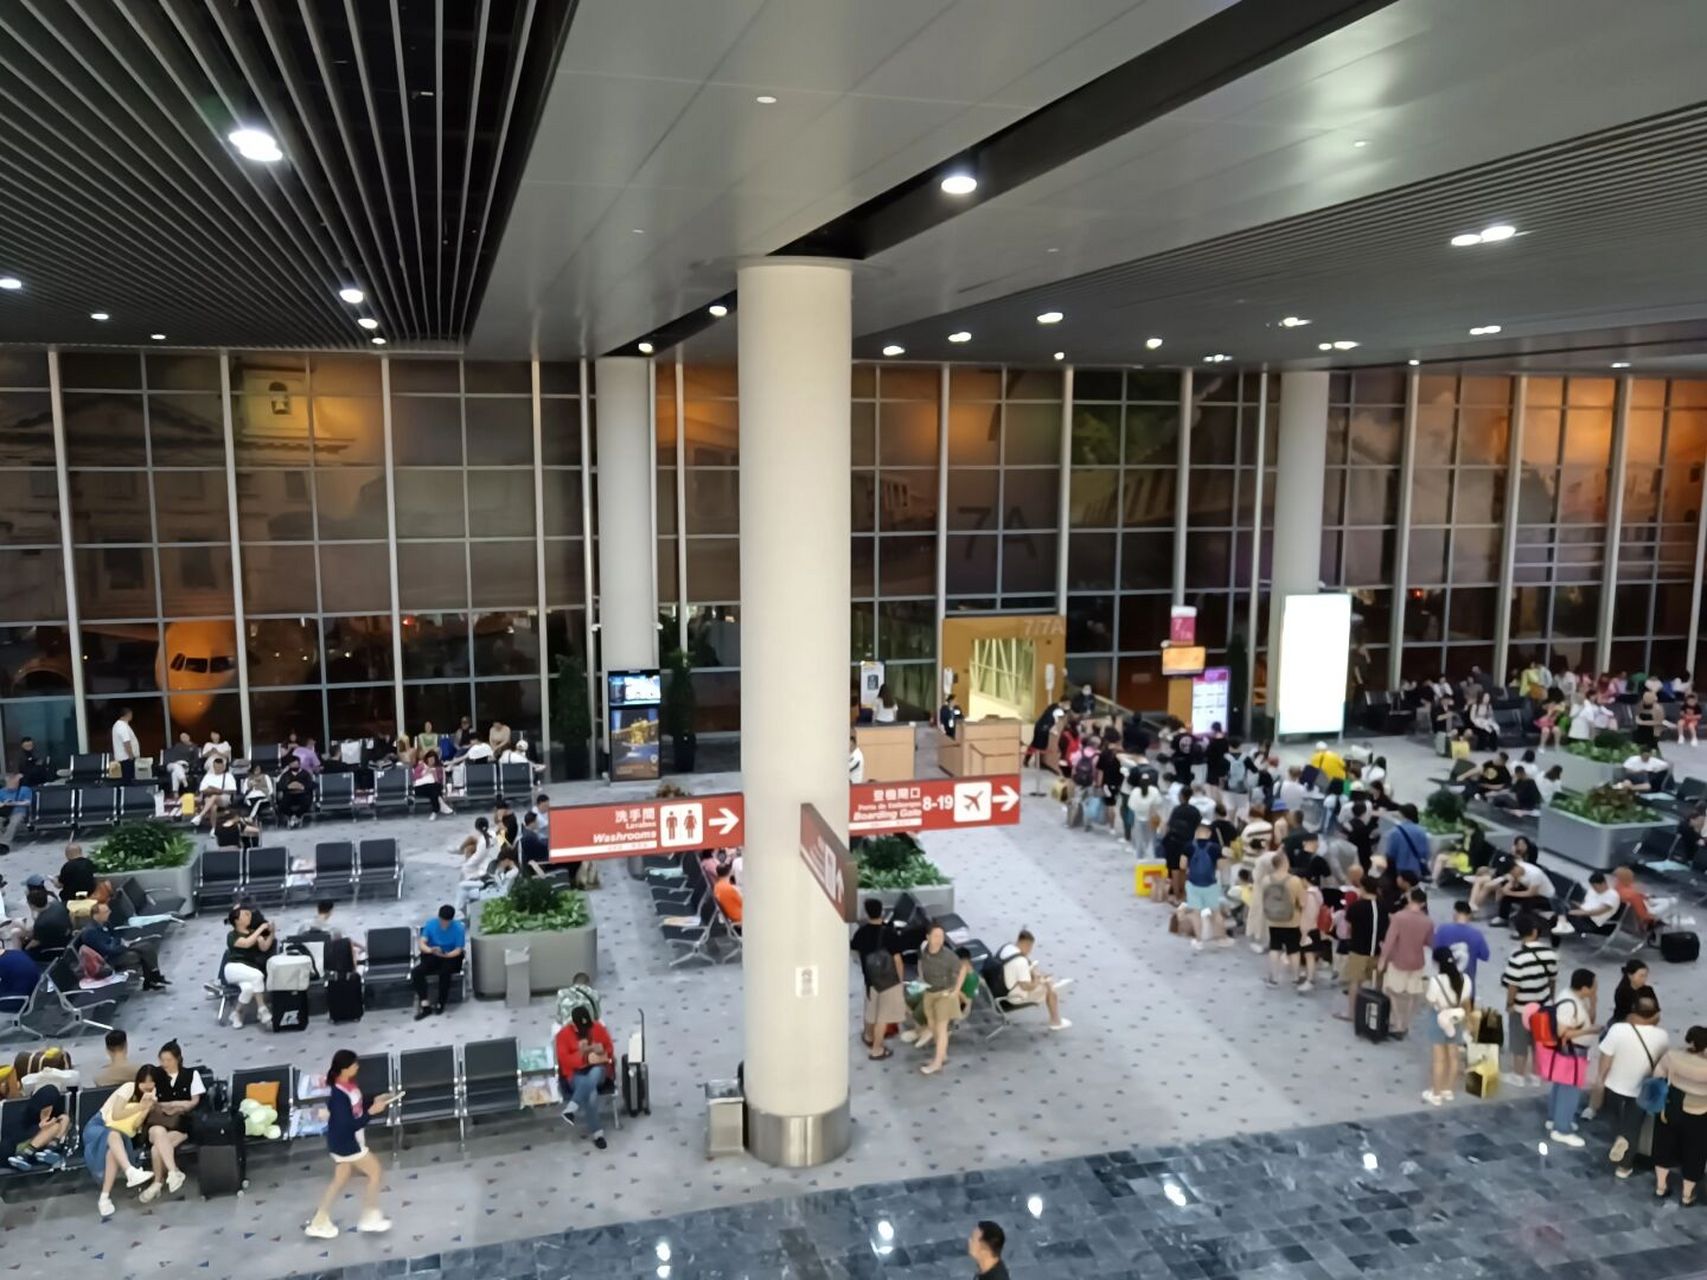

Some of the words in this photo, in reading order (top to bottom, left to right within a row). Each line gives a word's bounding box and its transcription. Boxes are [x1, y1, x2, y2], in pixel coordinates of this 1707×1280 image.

[957, 505, 1038, 561] 7A
[922, 795, 954, 811] 8-19
[853, 810, 898, 821] Boarding
[899, 809, 922, 818] Gate
[593, 830, 657, 844] Washrooms
